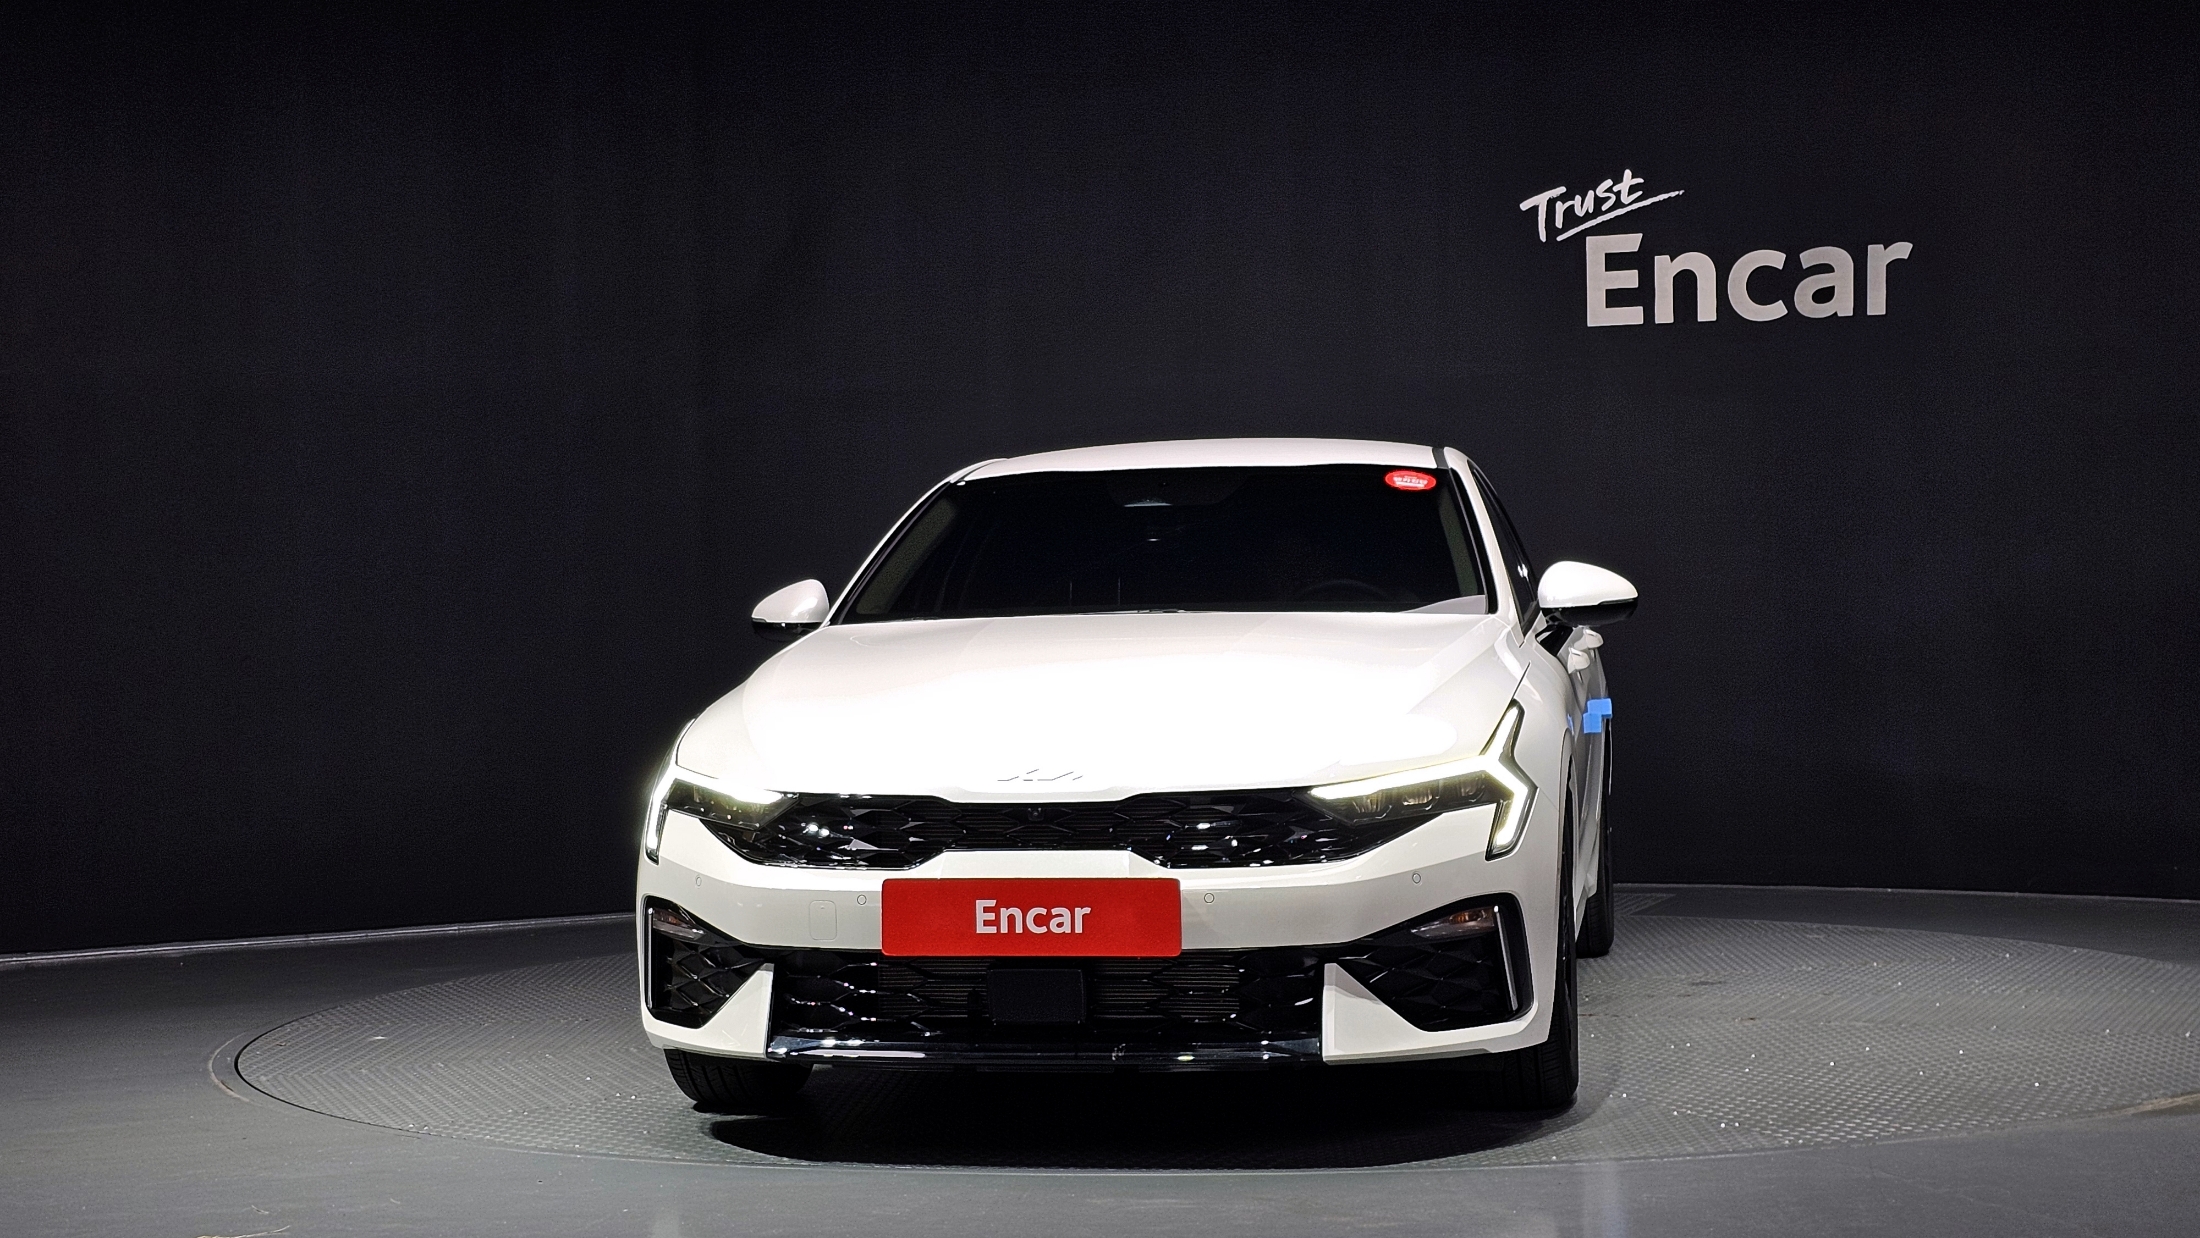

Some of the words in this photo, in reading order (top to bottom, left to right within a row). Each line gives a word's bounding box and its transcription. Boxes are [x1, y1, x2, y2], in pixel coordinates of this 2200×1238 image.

[1519, 168, 1645, 243] Trust
[1585, 232, 1914, 327] Encar
[975, 899, 1092, 934] Encar
